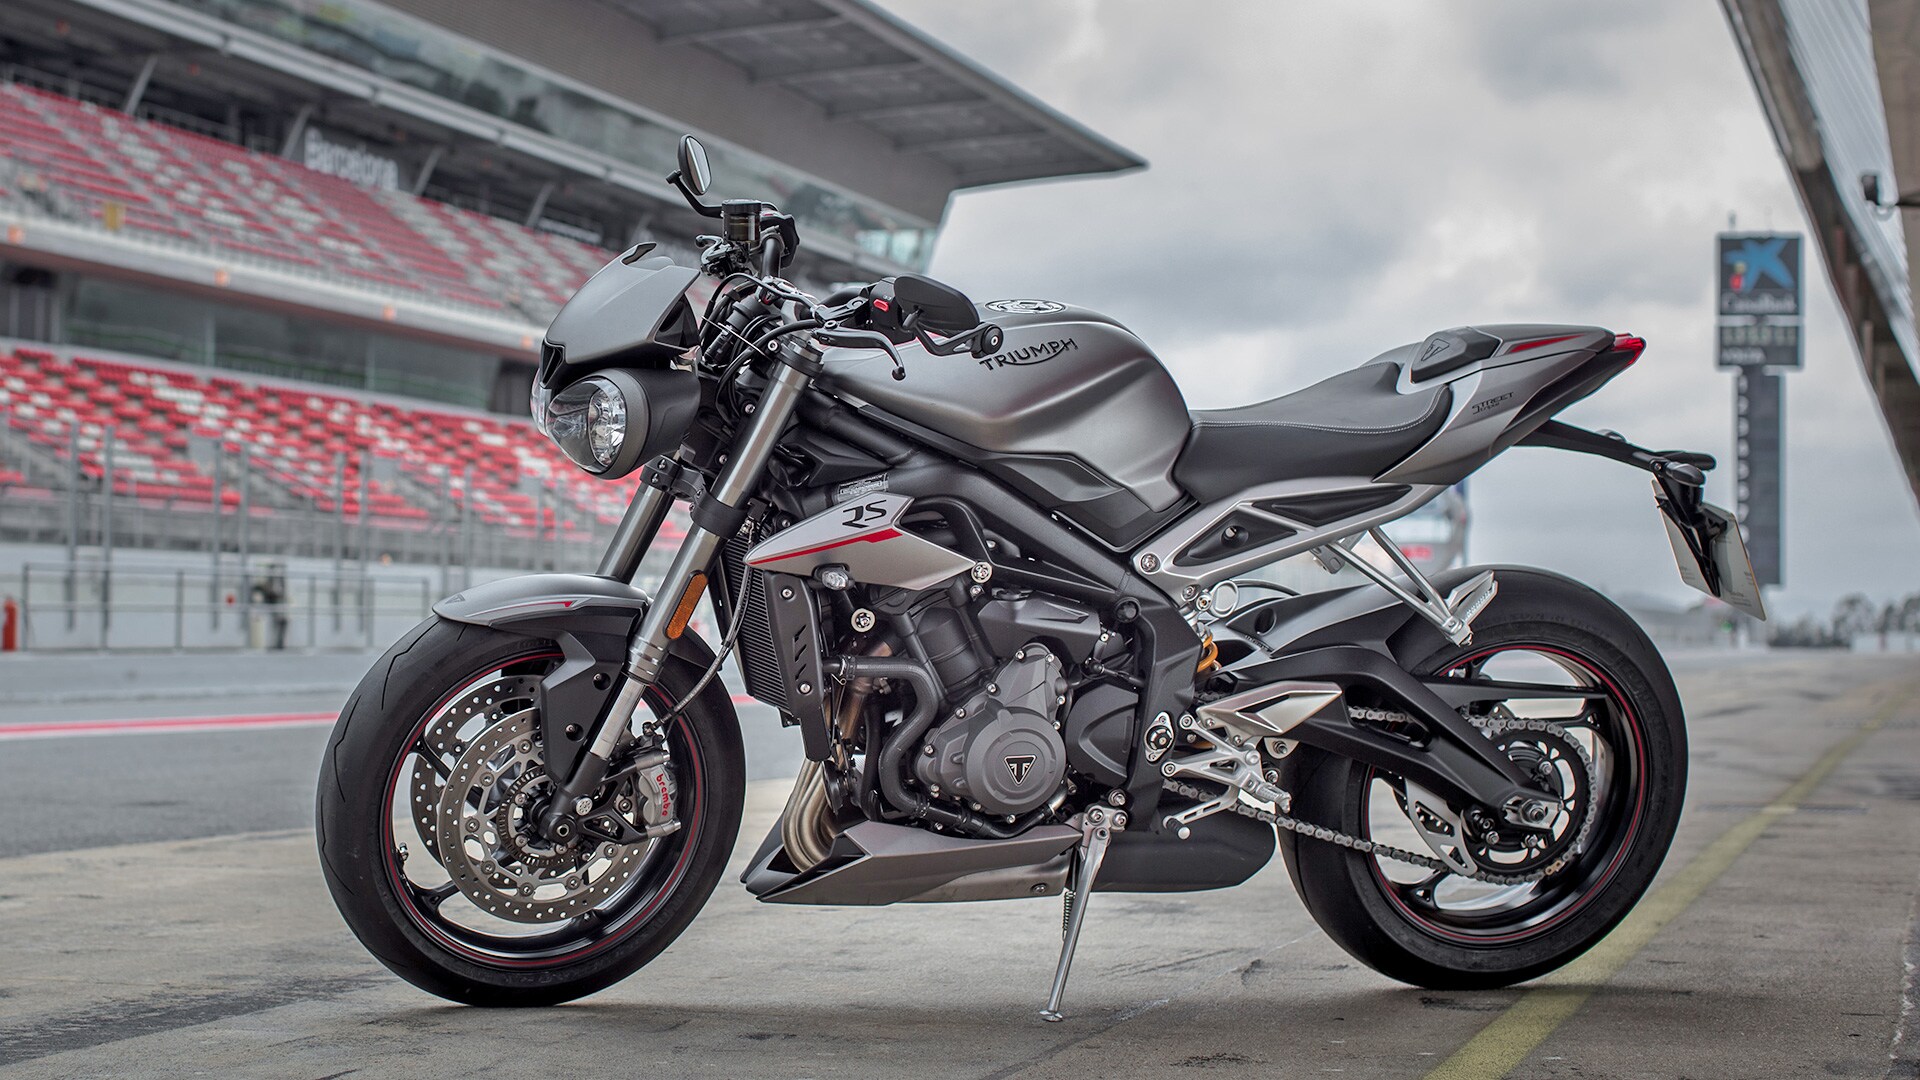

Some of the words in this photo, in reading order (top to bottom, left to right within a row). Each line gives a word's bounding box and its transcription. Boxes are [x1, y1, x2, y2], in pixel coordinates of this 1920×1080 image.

[979, 337, 1079, 371] TRIUMPH
[842, 499, 887, 529] RS
[656, 773, 671, 817] brembo
